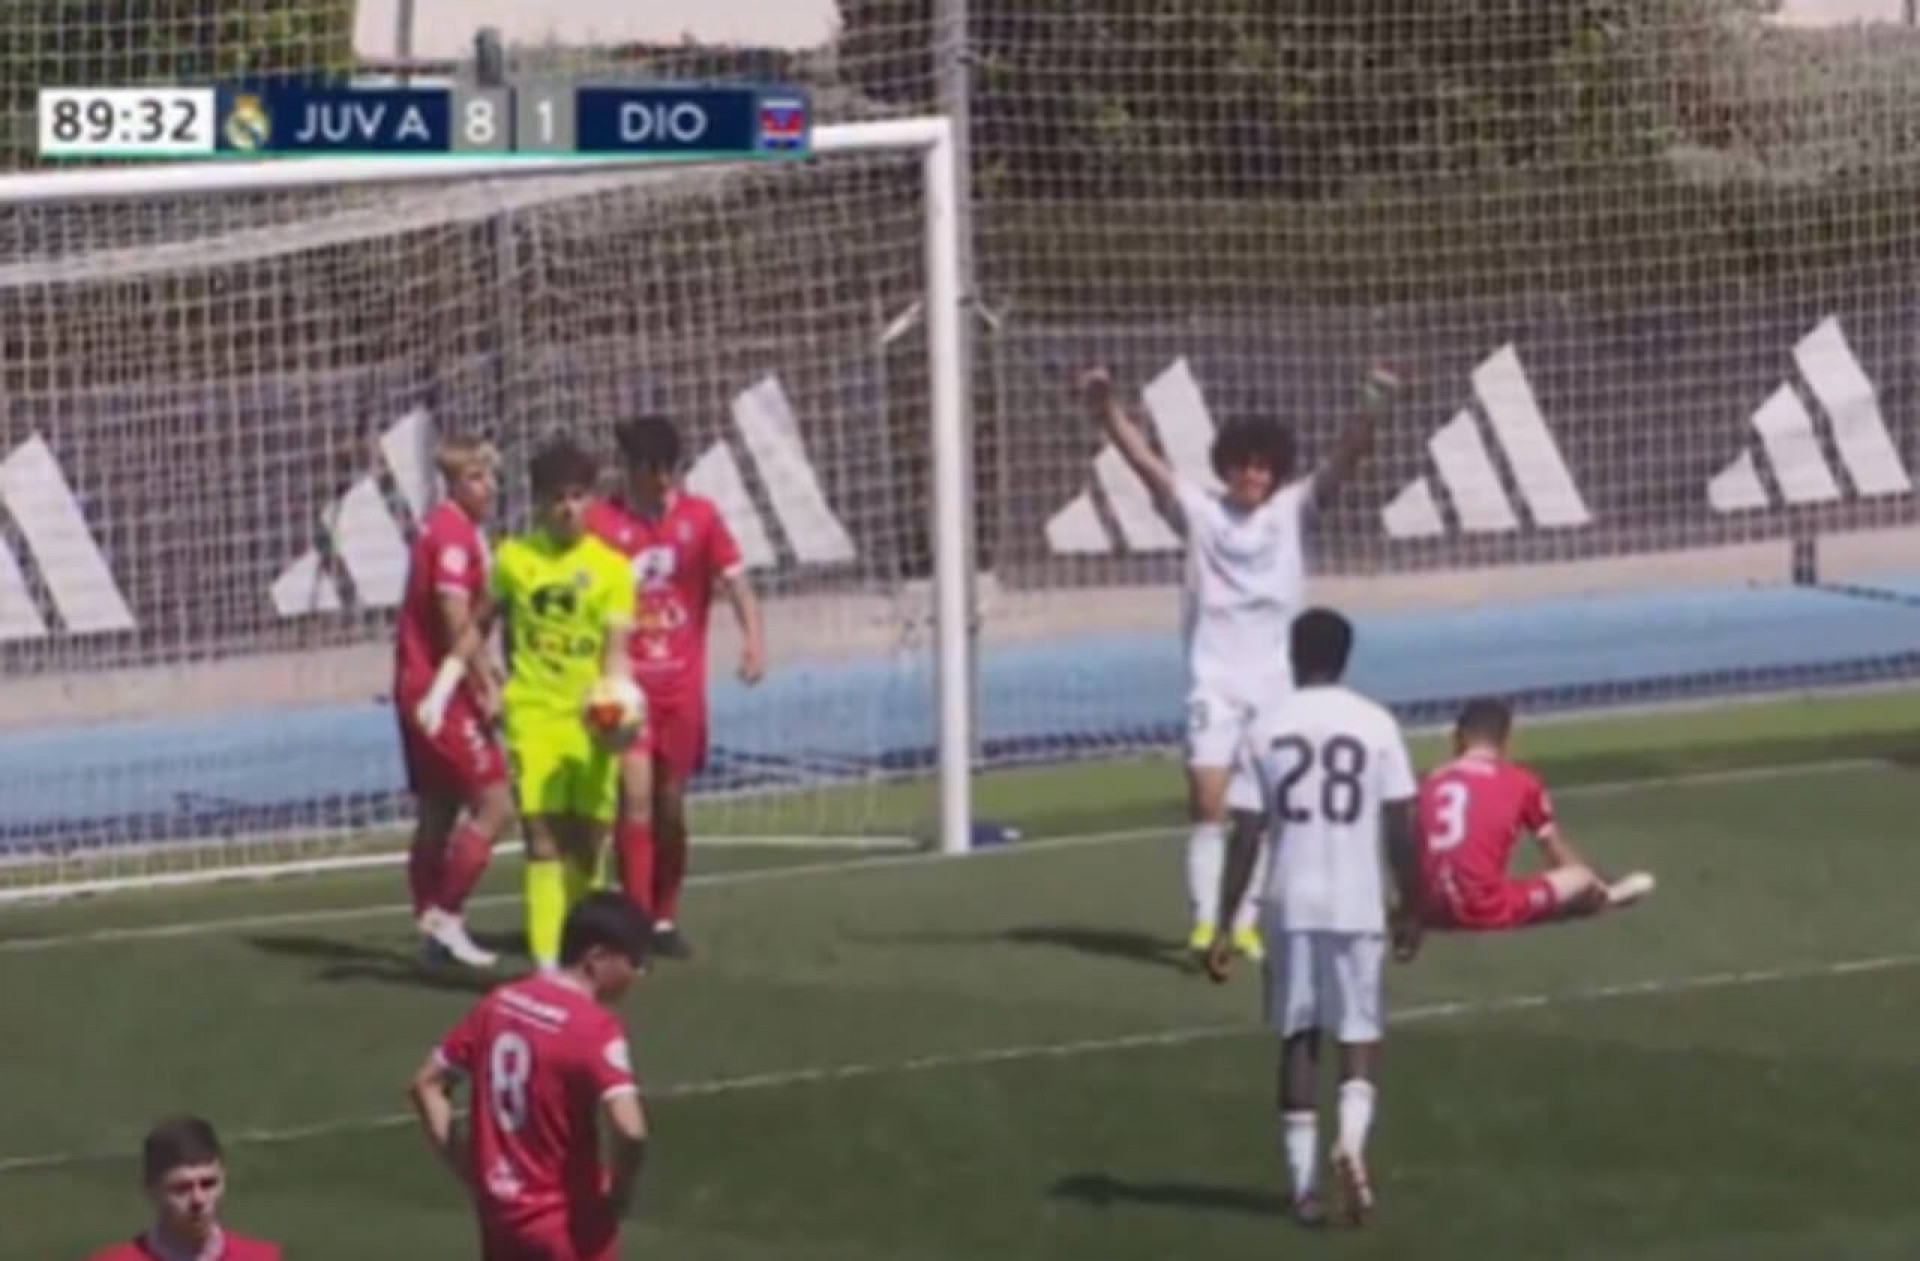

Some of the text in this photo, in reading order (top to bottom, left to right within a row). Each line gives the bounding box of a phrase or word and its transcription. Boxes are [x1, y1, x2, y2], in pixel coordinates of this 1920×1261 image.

[1270, 734, 1367, 825] 28
[1428, 780, 1469, 851] 3
[489, 1030, 532, 1134] 8
